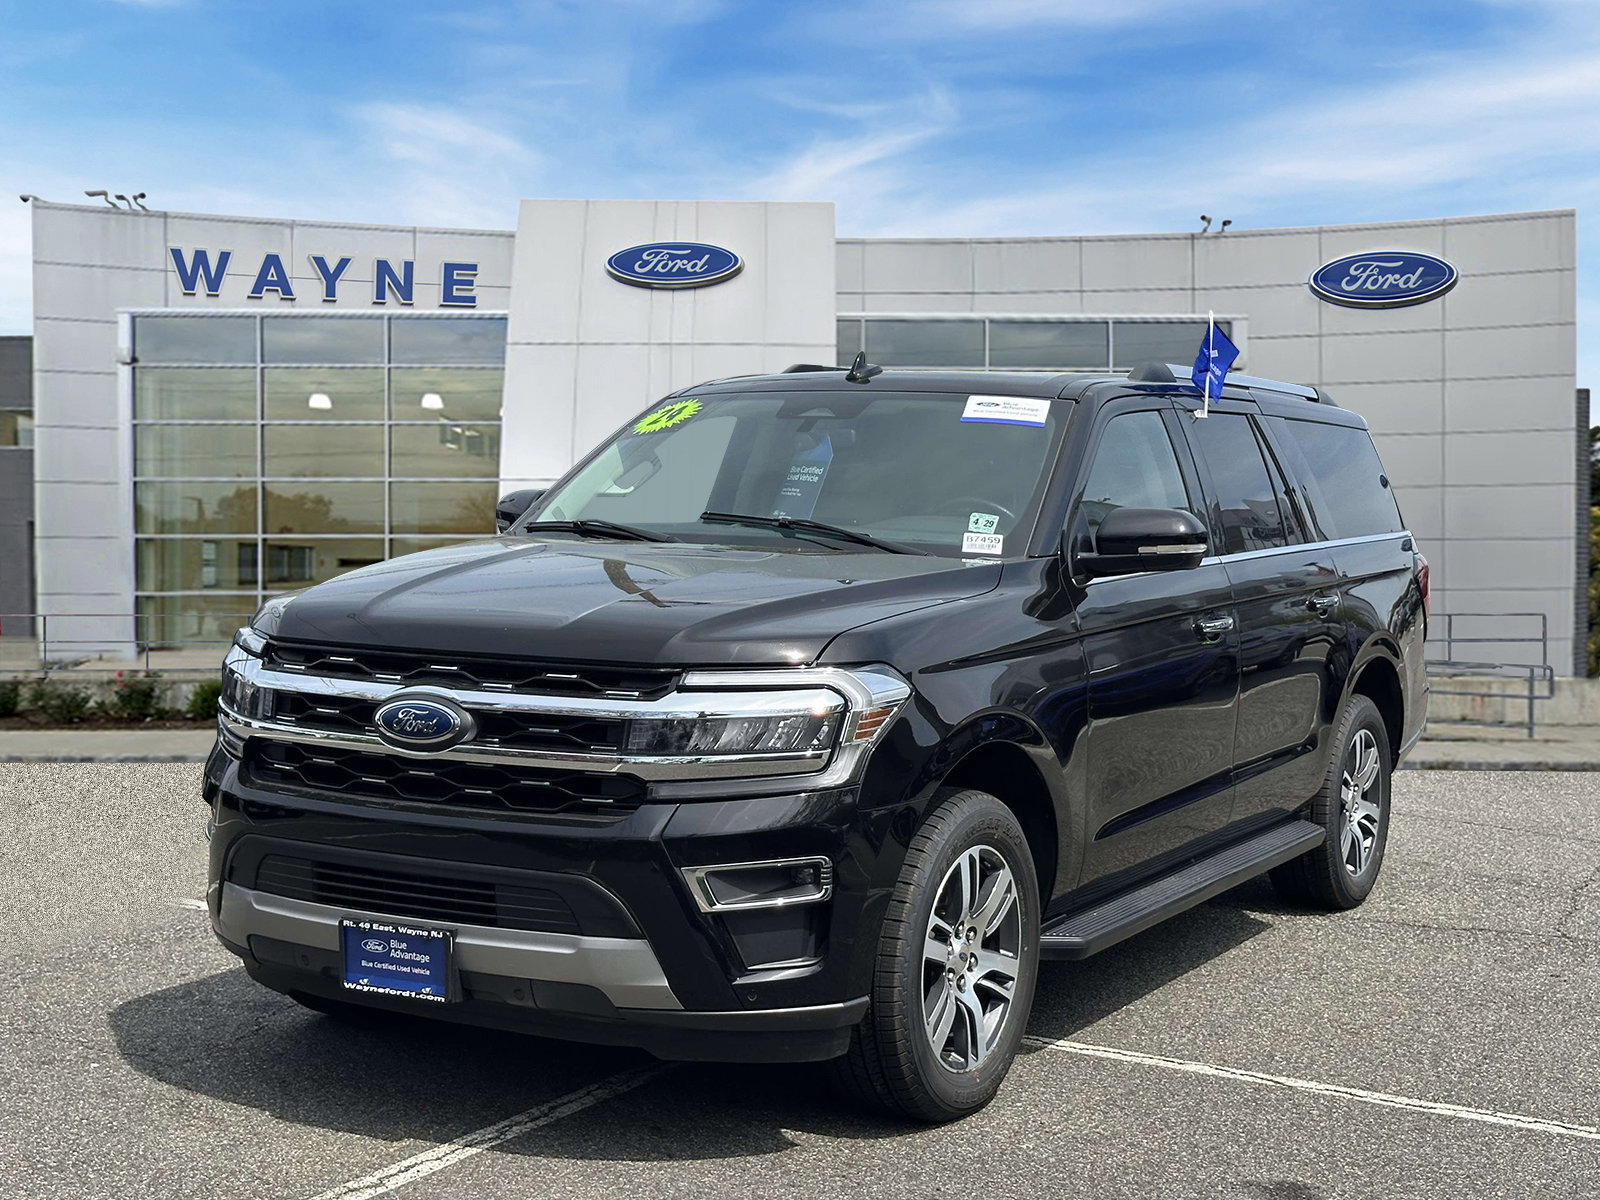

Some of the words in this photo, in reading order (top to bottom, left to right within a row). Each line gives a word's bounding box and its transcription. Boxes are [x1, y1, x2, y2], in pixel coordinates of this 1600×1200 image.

[634, 248, 710, 273] Ford
[169, 246, 479, 307] WAYNE
[1341, 260, 1425, 291] Ford
[983, 519, 995, 528] 29
[966, 535, 1001, 544] B7459
[393, 708, 439, 732] Ford
[343, 919, 357, 927] Rt.
[372, 923, 396, 933] East,
[398, 926, 429, 936] Wayne
[430, 930, 443, 938] NJ
[390, 939, 408, 950] Blue
[390, 949, 431, 963] Advantage
[361, 959, 373, 967] Blue
[373, 961, 396, 971] Certified
[411, 967, 430, 976] Vehicle
[343, 982, 446, 1003] Wayneford1.com
